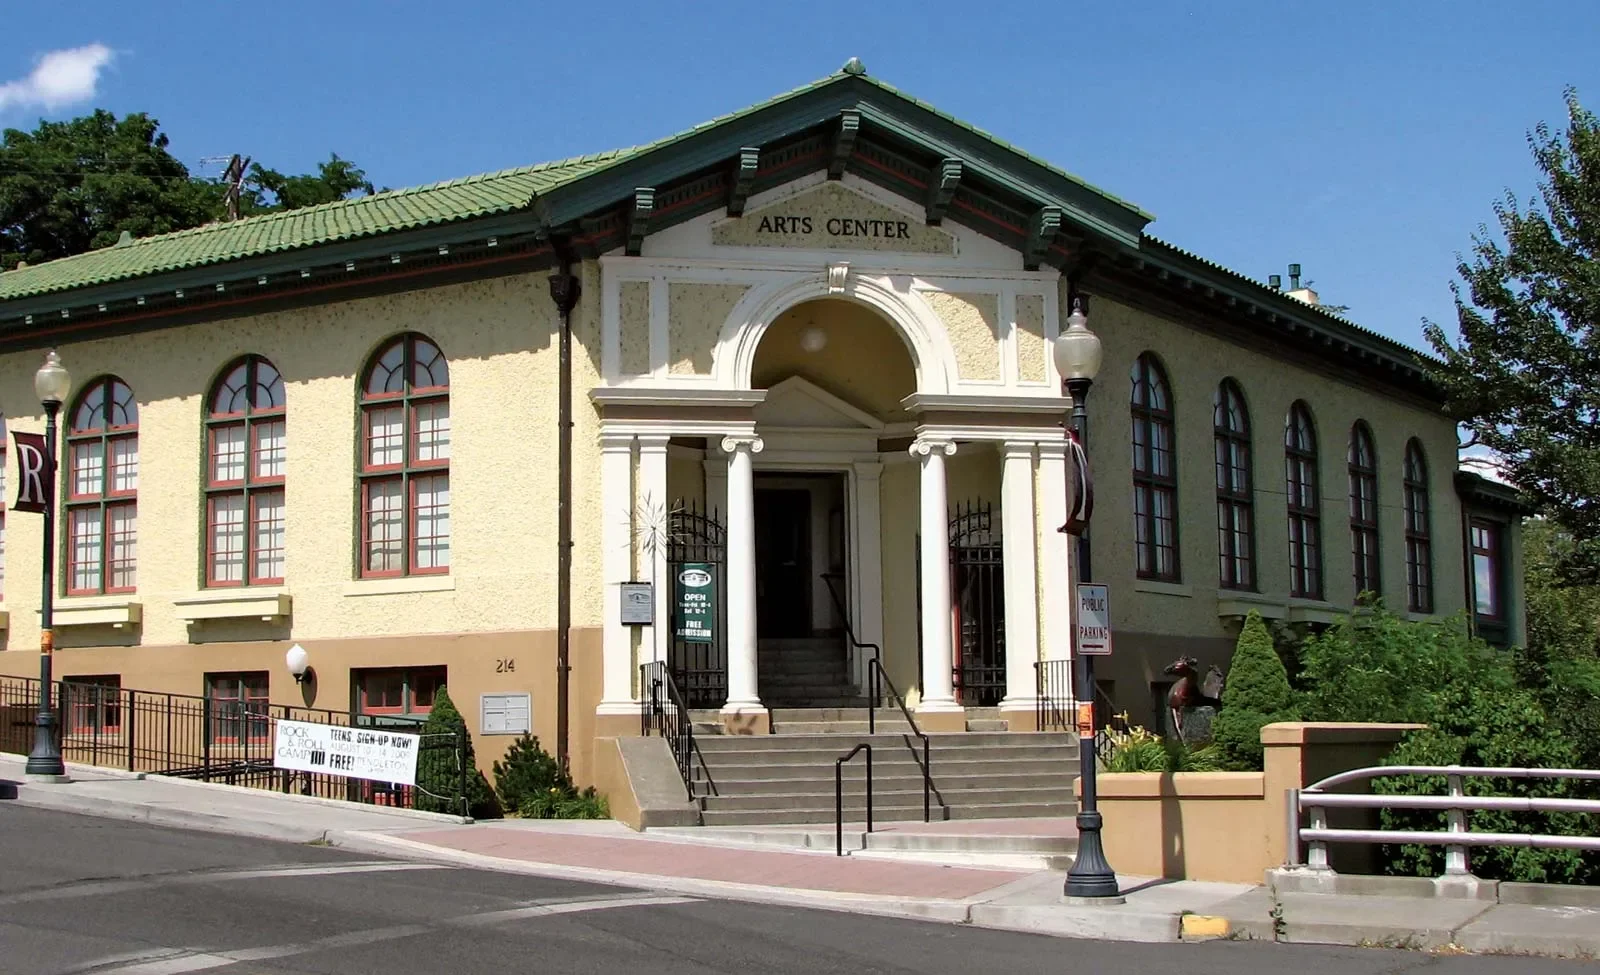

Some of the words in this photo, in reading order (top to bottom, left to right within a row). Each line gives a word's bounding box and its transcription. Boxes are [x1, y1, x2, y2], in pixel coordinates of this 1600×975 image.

[757, 216, 813, 234] ARTS
[826, 218, 910, 239] CENTER
[17, 443, 46, 504] R
[684, 593, 706, 601] OPEN
[1081, 599, 1105, 612] PUBLIC
[685, 620, 702, 628] FREE
[676, 628, 711, 637] ADMISSION
[1080, 626, 1108, 640] PARKING
[496, 659, 515, 673] 214
[280, 725, 309, 738] ROCK
[298, 738, 326, 750] ROLL
[278, 747, 311, 760] CAMP
[329, 753, 355, 771] FREE!
